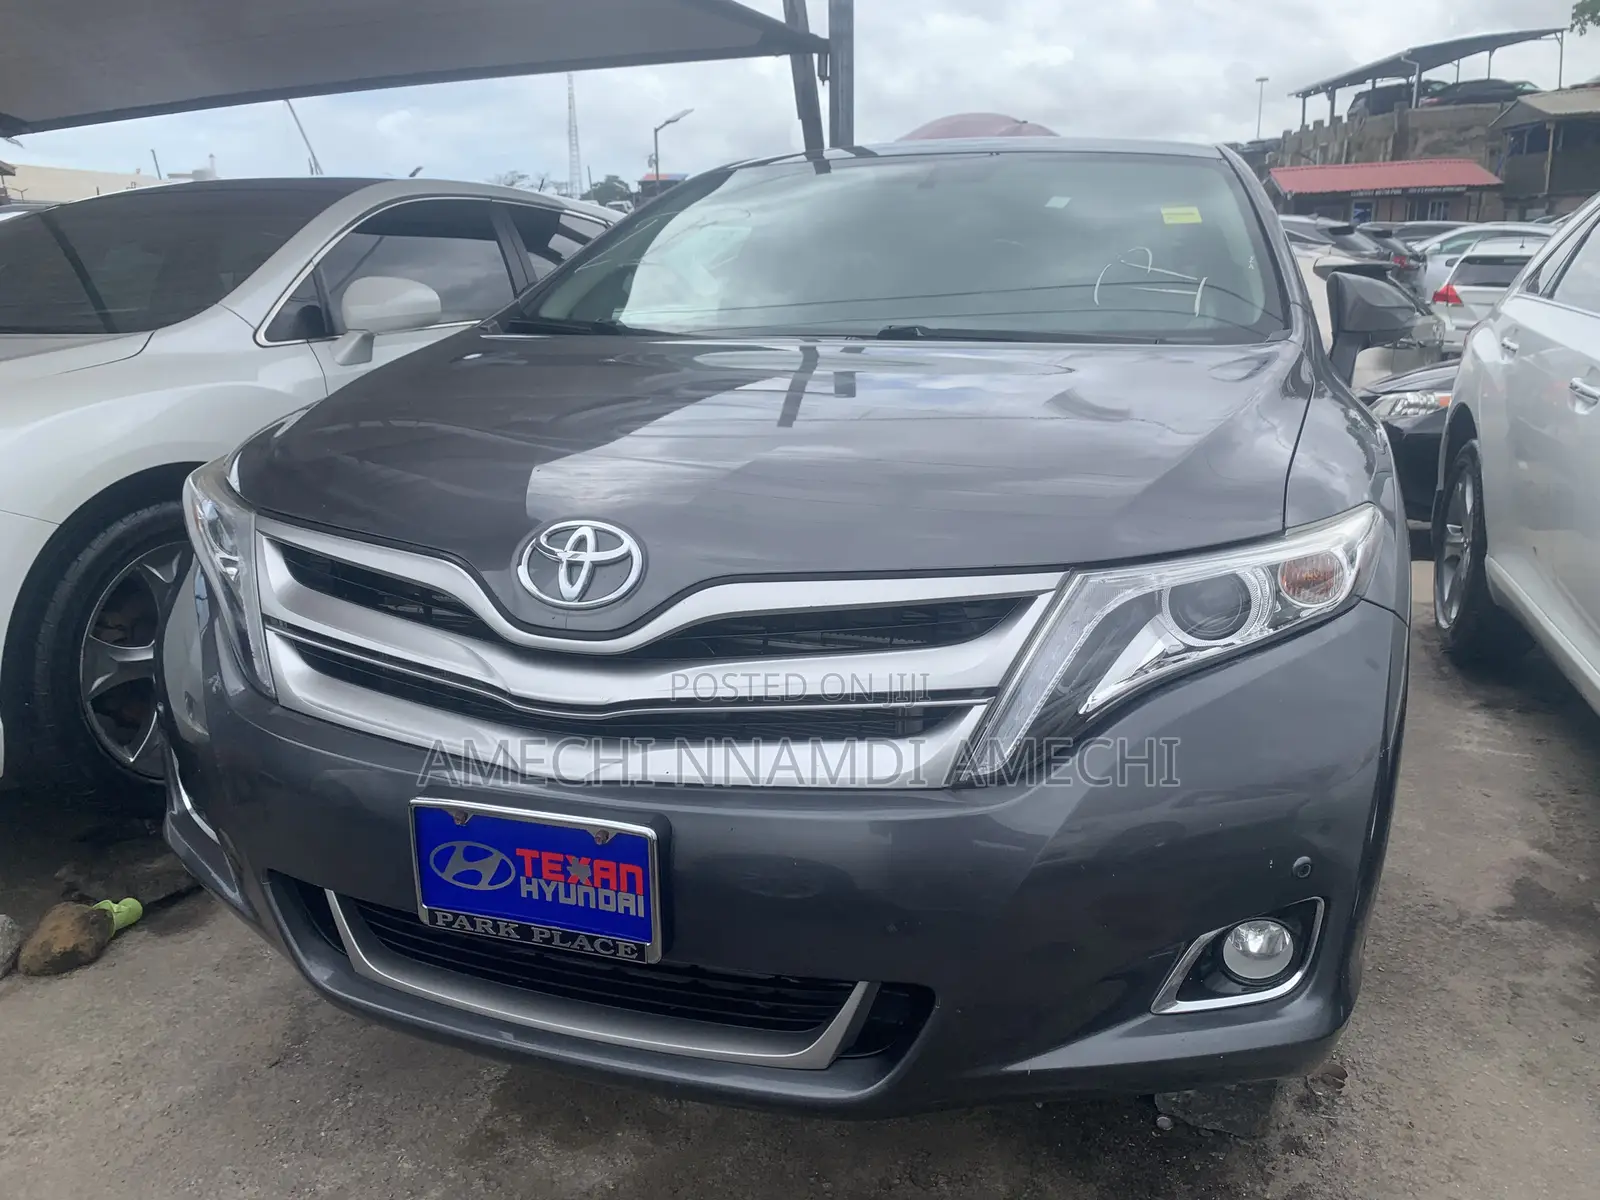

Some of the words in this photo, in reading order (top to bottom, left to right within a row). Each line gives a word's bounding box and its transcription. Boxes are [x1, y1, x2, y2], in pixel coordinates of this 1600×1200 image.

[516, 848, 644, 895] TEXAN
[519, 877, 645, 917] HYUNDAI
[434, 911, 520, 939] PARK
[531, 926, 639, 959] PLACE
